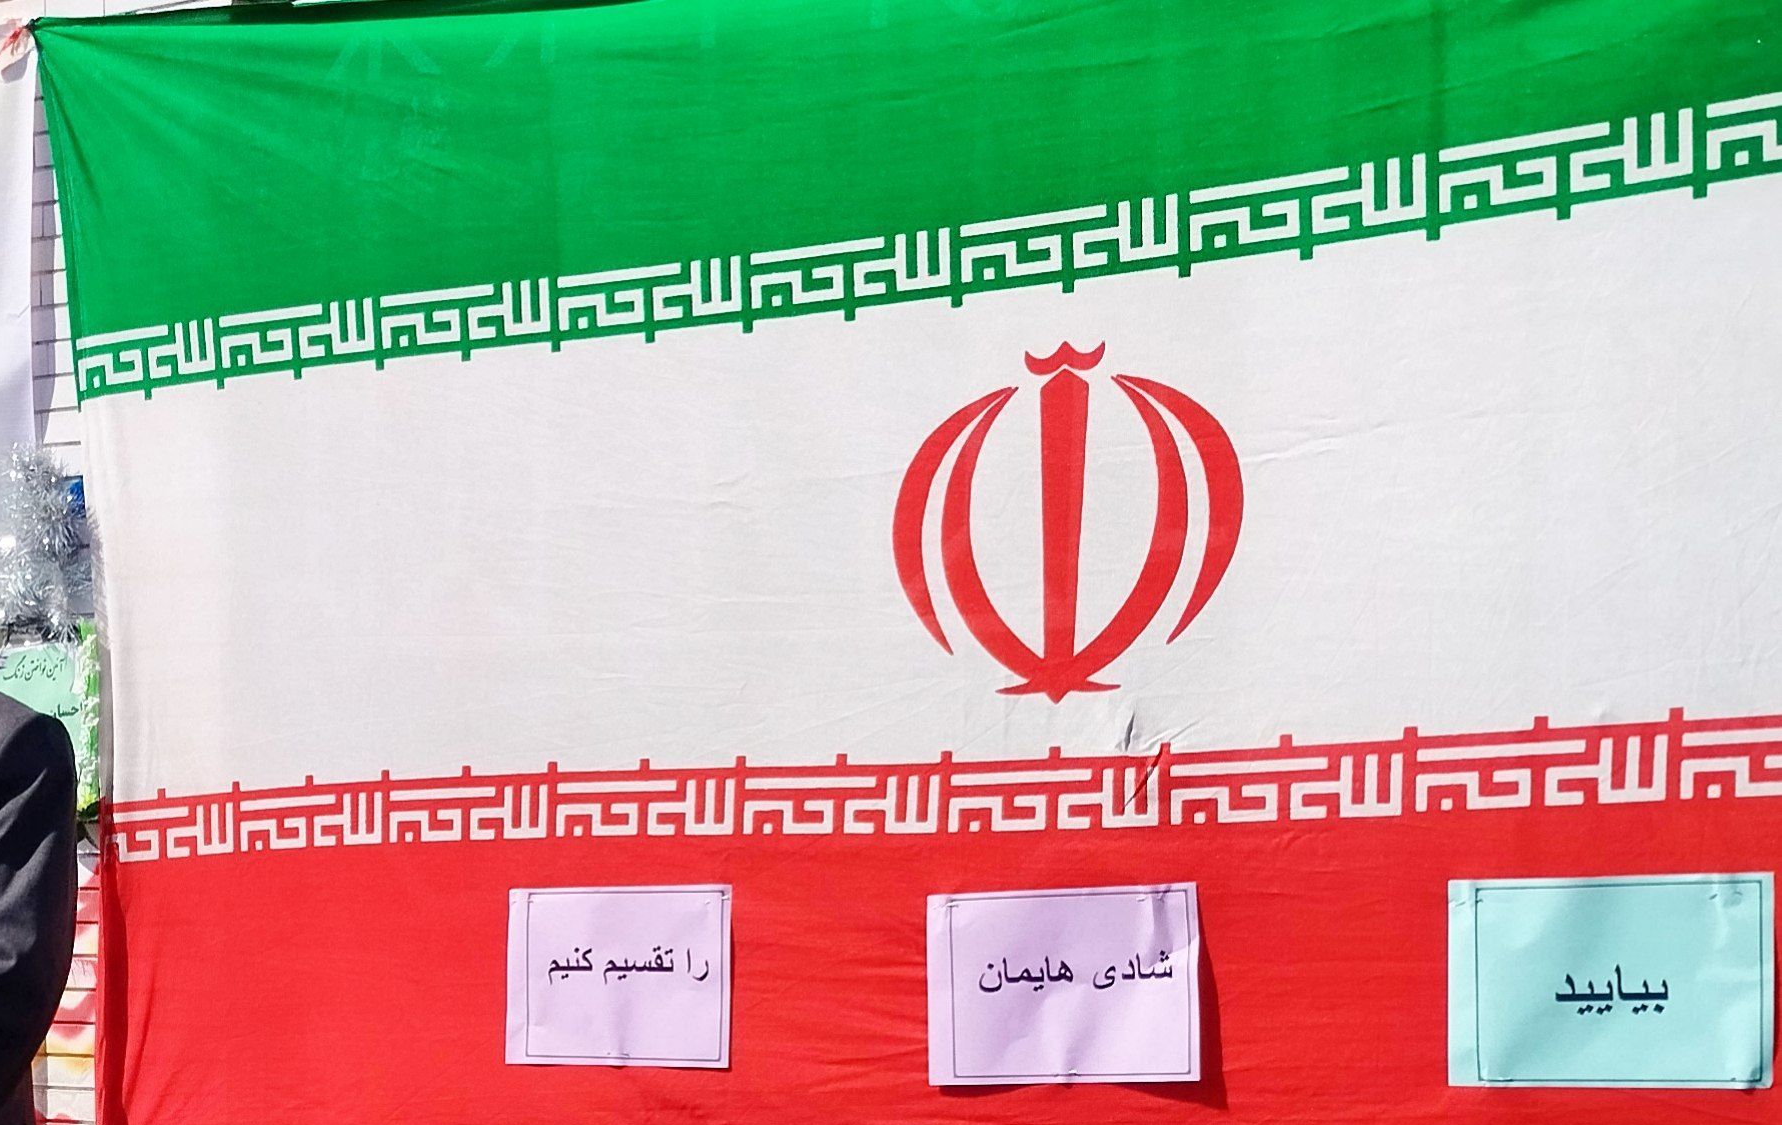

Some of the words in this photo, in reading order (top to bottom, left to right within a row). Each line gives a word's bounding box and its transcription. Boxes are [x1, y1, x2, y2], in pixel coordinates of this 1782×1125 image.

[548, 949, 593, 986] کنیم
[602, 947, 675, 986] تقسیم
[687, 950, 709, 981] را
[979, 956, 1075, 994] هایمان
[1093, 949, 1174, 989] شادی
[1555, 964, 1669, 1015] بیایید
